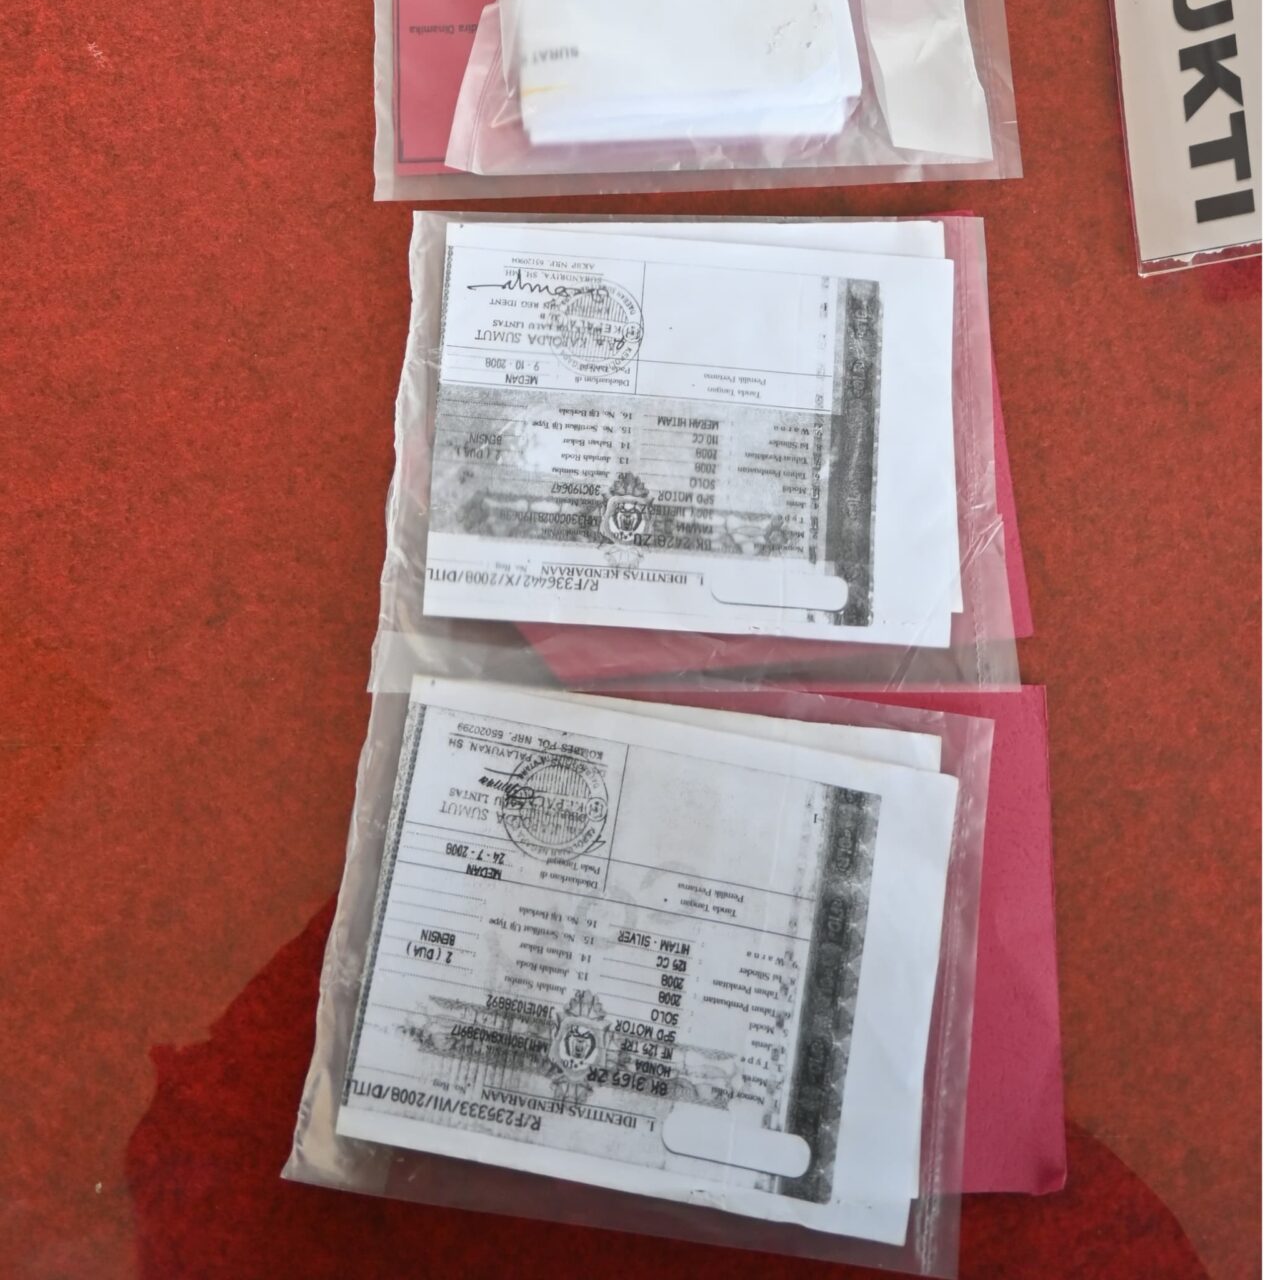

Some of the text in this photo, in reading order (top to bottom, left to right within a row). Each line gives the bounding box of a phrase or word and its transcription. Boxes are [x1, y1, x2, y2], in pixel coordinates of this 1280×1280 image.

[409, 25, 454, 35] Dinamika
[489, 298, 539, 309] REG IDENT
[492, 319, 524, 329] LINTAS
[474, 329, 521, 345] SUMUT
[485, 358, 540, 371] 9 10 2008
[505, 374, 538, 385] MEDAN
[657, 416, 719, 430] MERAH HITAM
[690, 479, 716, 490] SOLO
[658, 490, 715, 504] SPD MOTOR
[541, 565, 687, 584] IDENTITAS KENDARAAN
[537, 738, 557, 752] POL
[561, 743, 604, 760] KOMBES
[449, 787, 489, 804] LINTAS
[438, 800, 488, 821] SUMUT
[445, 843, 505, 863] 24 7 2008
[466, 864, 502, 880] MEDAN
[550, 872, 598, 889] Dikeluarkan
[677, 882, 744, 902] Pemilik Pertama
[518, 906, 549, 920] Berkala
[679, 898, 736, 918] Tanda Tangan
[488, 917, 558, 939] Sertifikat Uji Type
[420, 929, 456, 946] BENSIN
[617, 930, 690, 955] HITAM SILVER
[413, 944, 453, 964] 2 DUA
[519, 942, 573, 960] Bahan Bakar
[516, 960, 537, 972] Roda
[656, 956, 687, 972] 125 CC
[660, 974, 685, 990] 2008
[739, 967, 770, 981] Silinder
[712, 979, 779, 1000] Tahun Perakitan
[658, 991, 682, 1007] 2008
[703, 995, 777, 1018] Tahun Pembuatan
[651, 1009, 679, 1024] SOLO
[614, 1019, 676, 1042] SPD MOTOR
[749, 1021, 775, 1034] Model
[620, 1040, 657, 1057] 125 TRF
[635, 1060, 671, 1078] HONDA
[588, 1067, 668, 1096] BK 3165 ZR
[480, 1088, 637, 1128] IDENTITAS KENDARAAN
